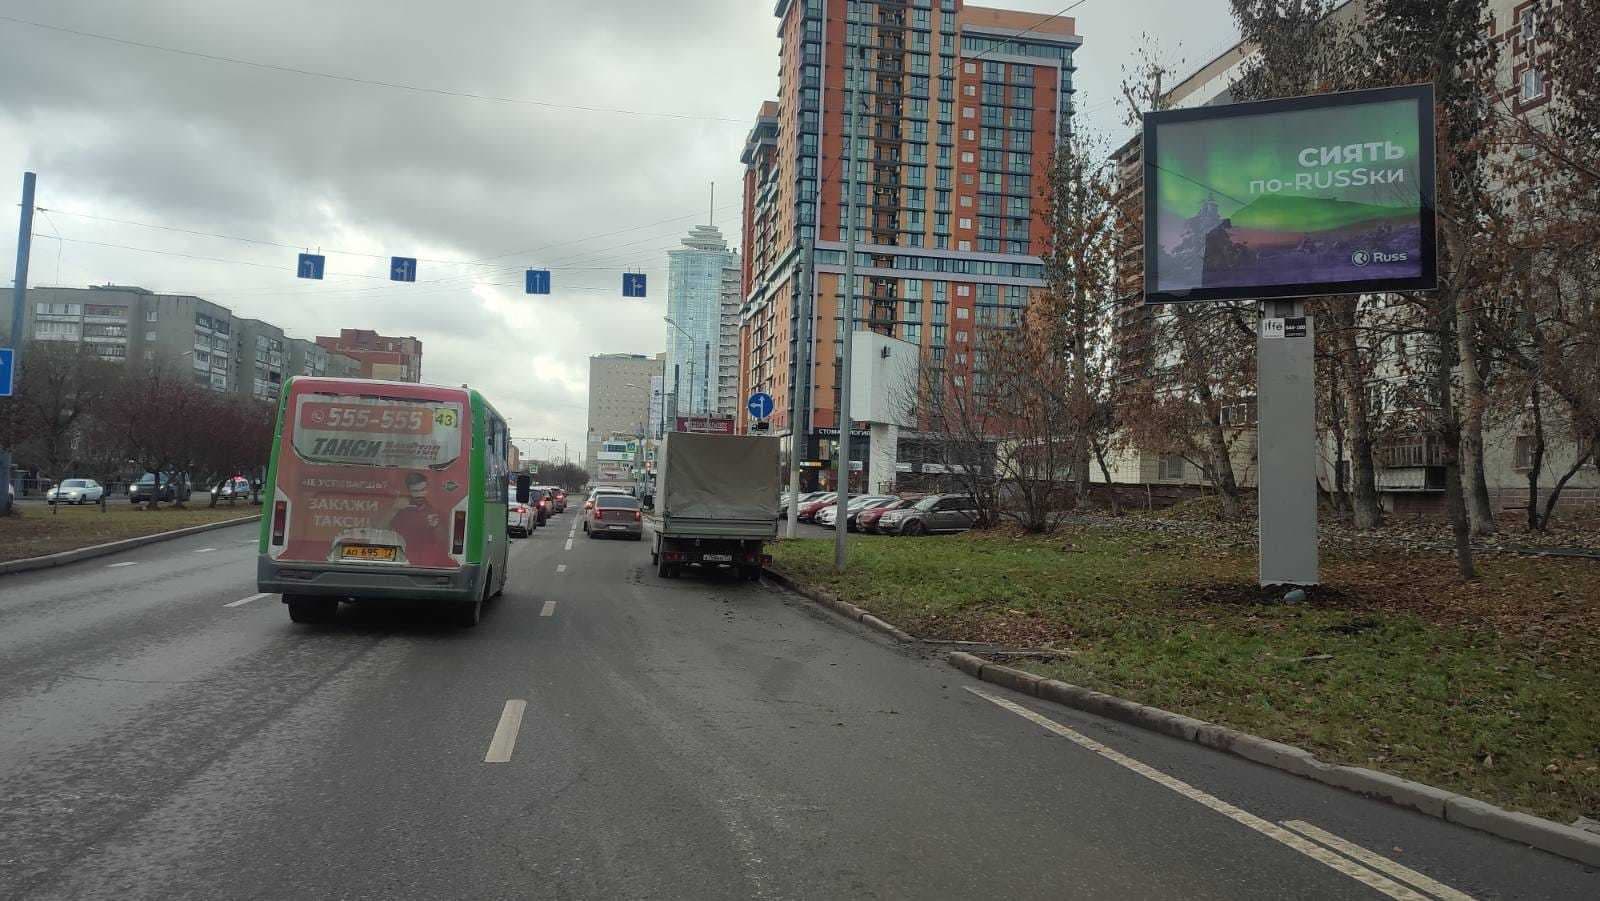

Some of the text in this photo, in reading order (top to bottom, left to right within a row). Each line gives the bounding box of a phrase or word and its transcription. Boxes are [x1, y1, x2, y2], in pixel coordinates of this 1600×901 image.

[1373, 252, 1408, 263] Russ
[327, 407, 423, 430] 555-555
[434, 414, 453, 426] 43
[311, 438, 382, 458] ТАКСИ
[309, 498, 378, 511] ЗАКАЖИ
